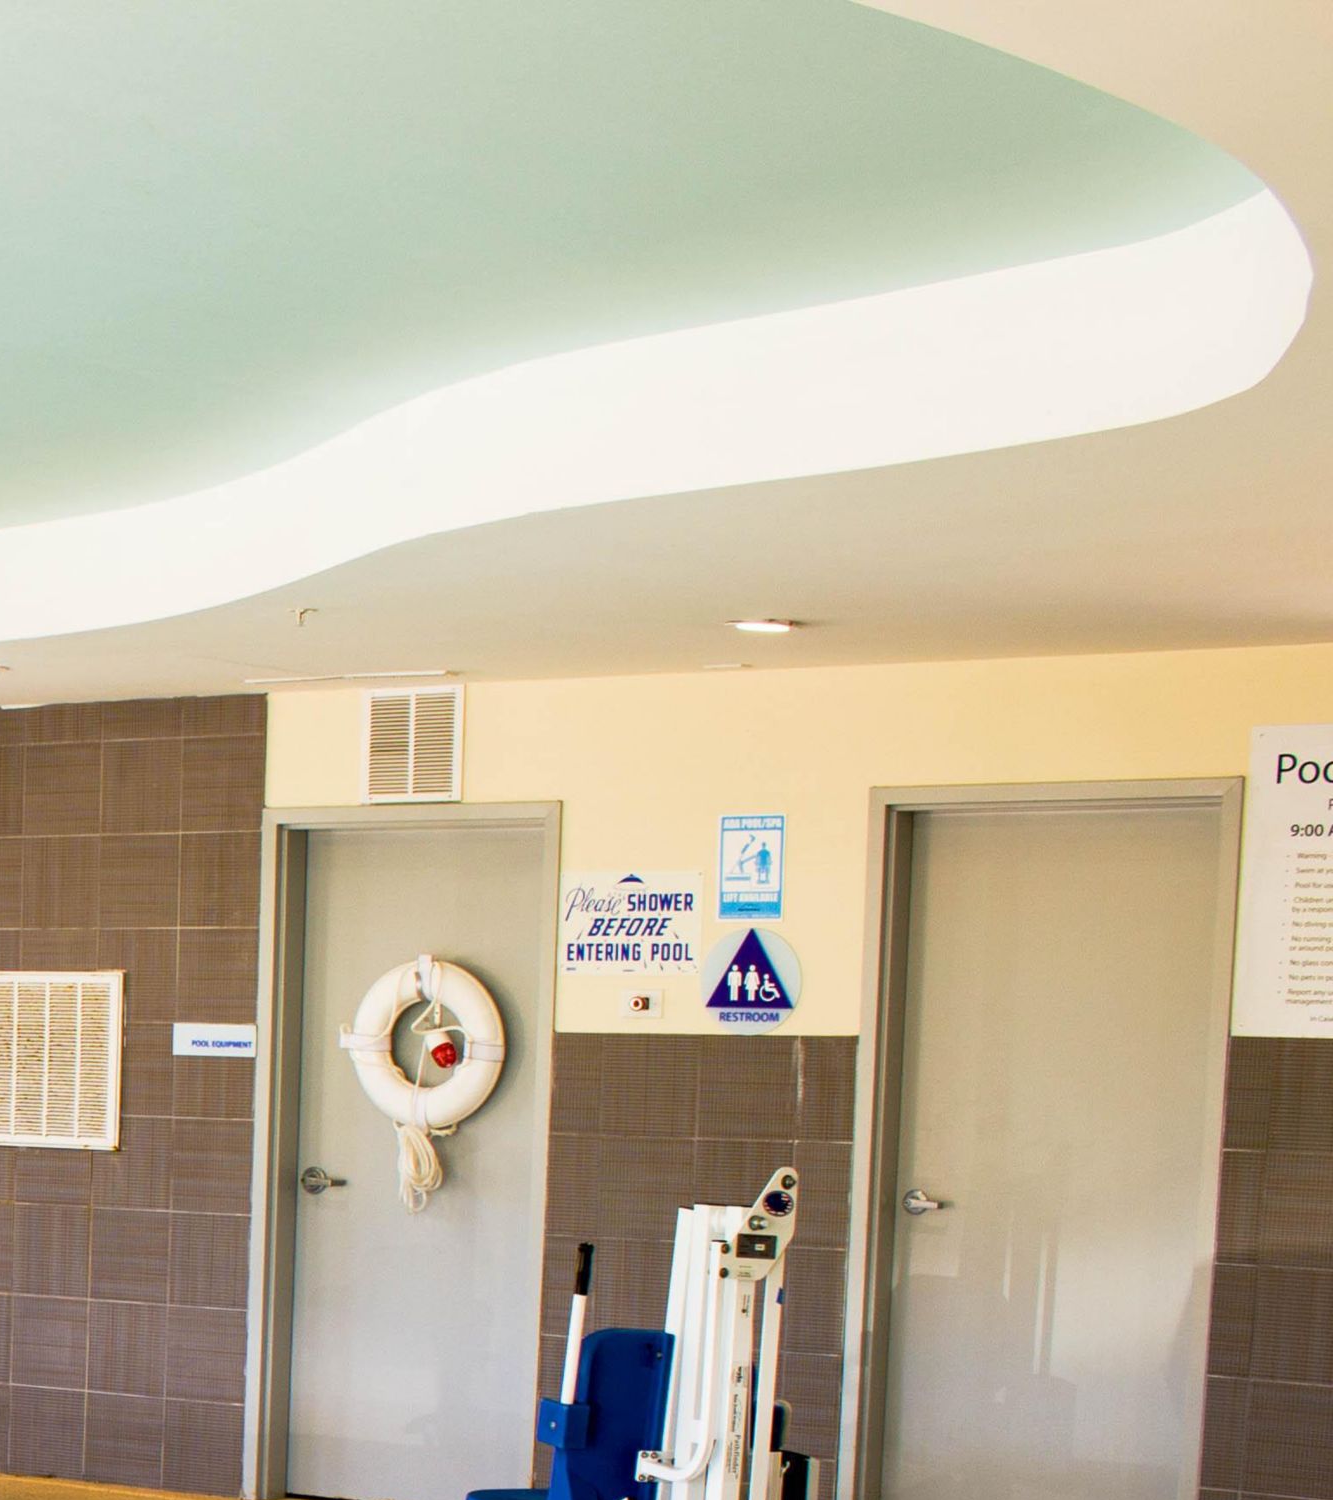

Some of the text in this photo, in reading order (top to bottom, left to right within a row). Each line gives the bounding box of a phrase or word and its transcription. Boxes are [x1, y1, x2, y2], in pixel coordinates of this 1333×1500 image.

[1290, 823, 1324, 837] 9:00
[565, 885, 694, 921] Please SHOWER
[587, 917, 672, 937] BEFORE
[567, 943, 694, 961] ENTERING POOL
[719, 1011, 780, 1023] RESTROOM
[191, 1039, 253, 1049] POOL EQUIPMENT
